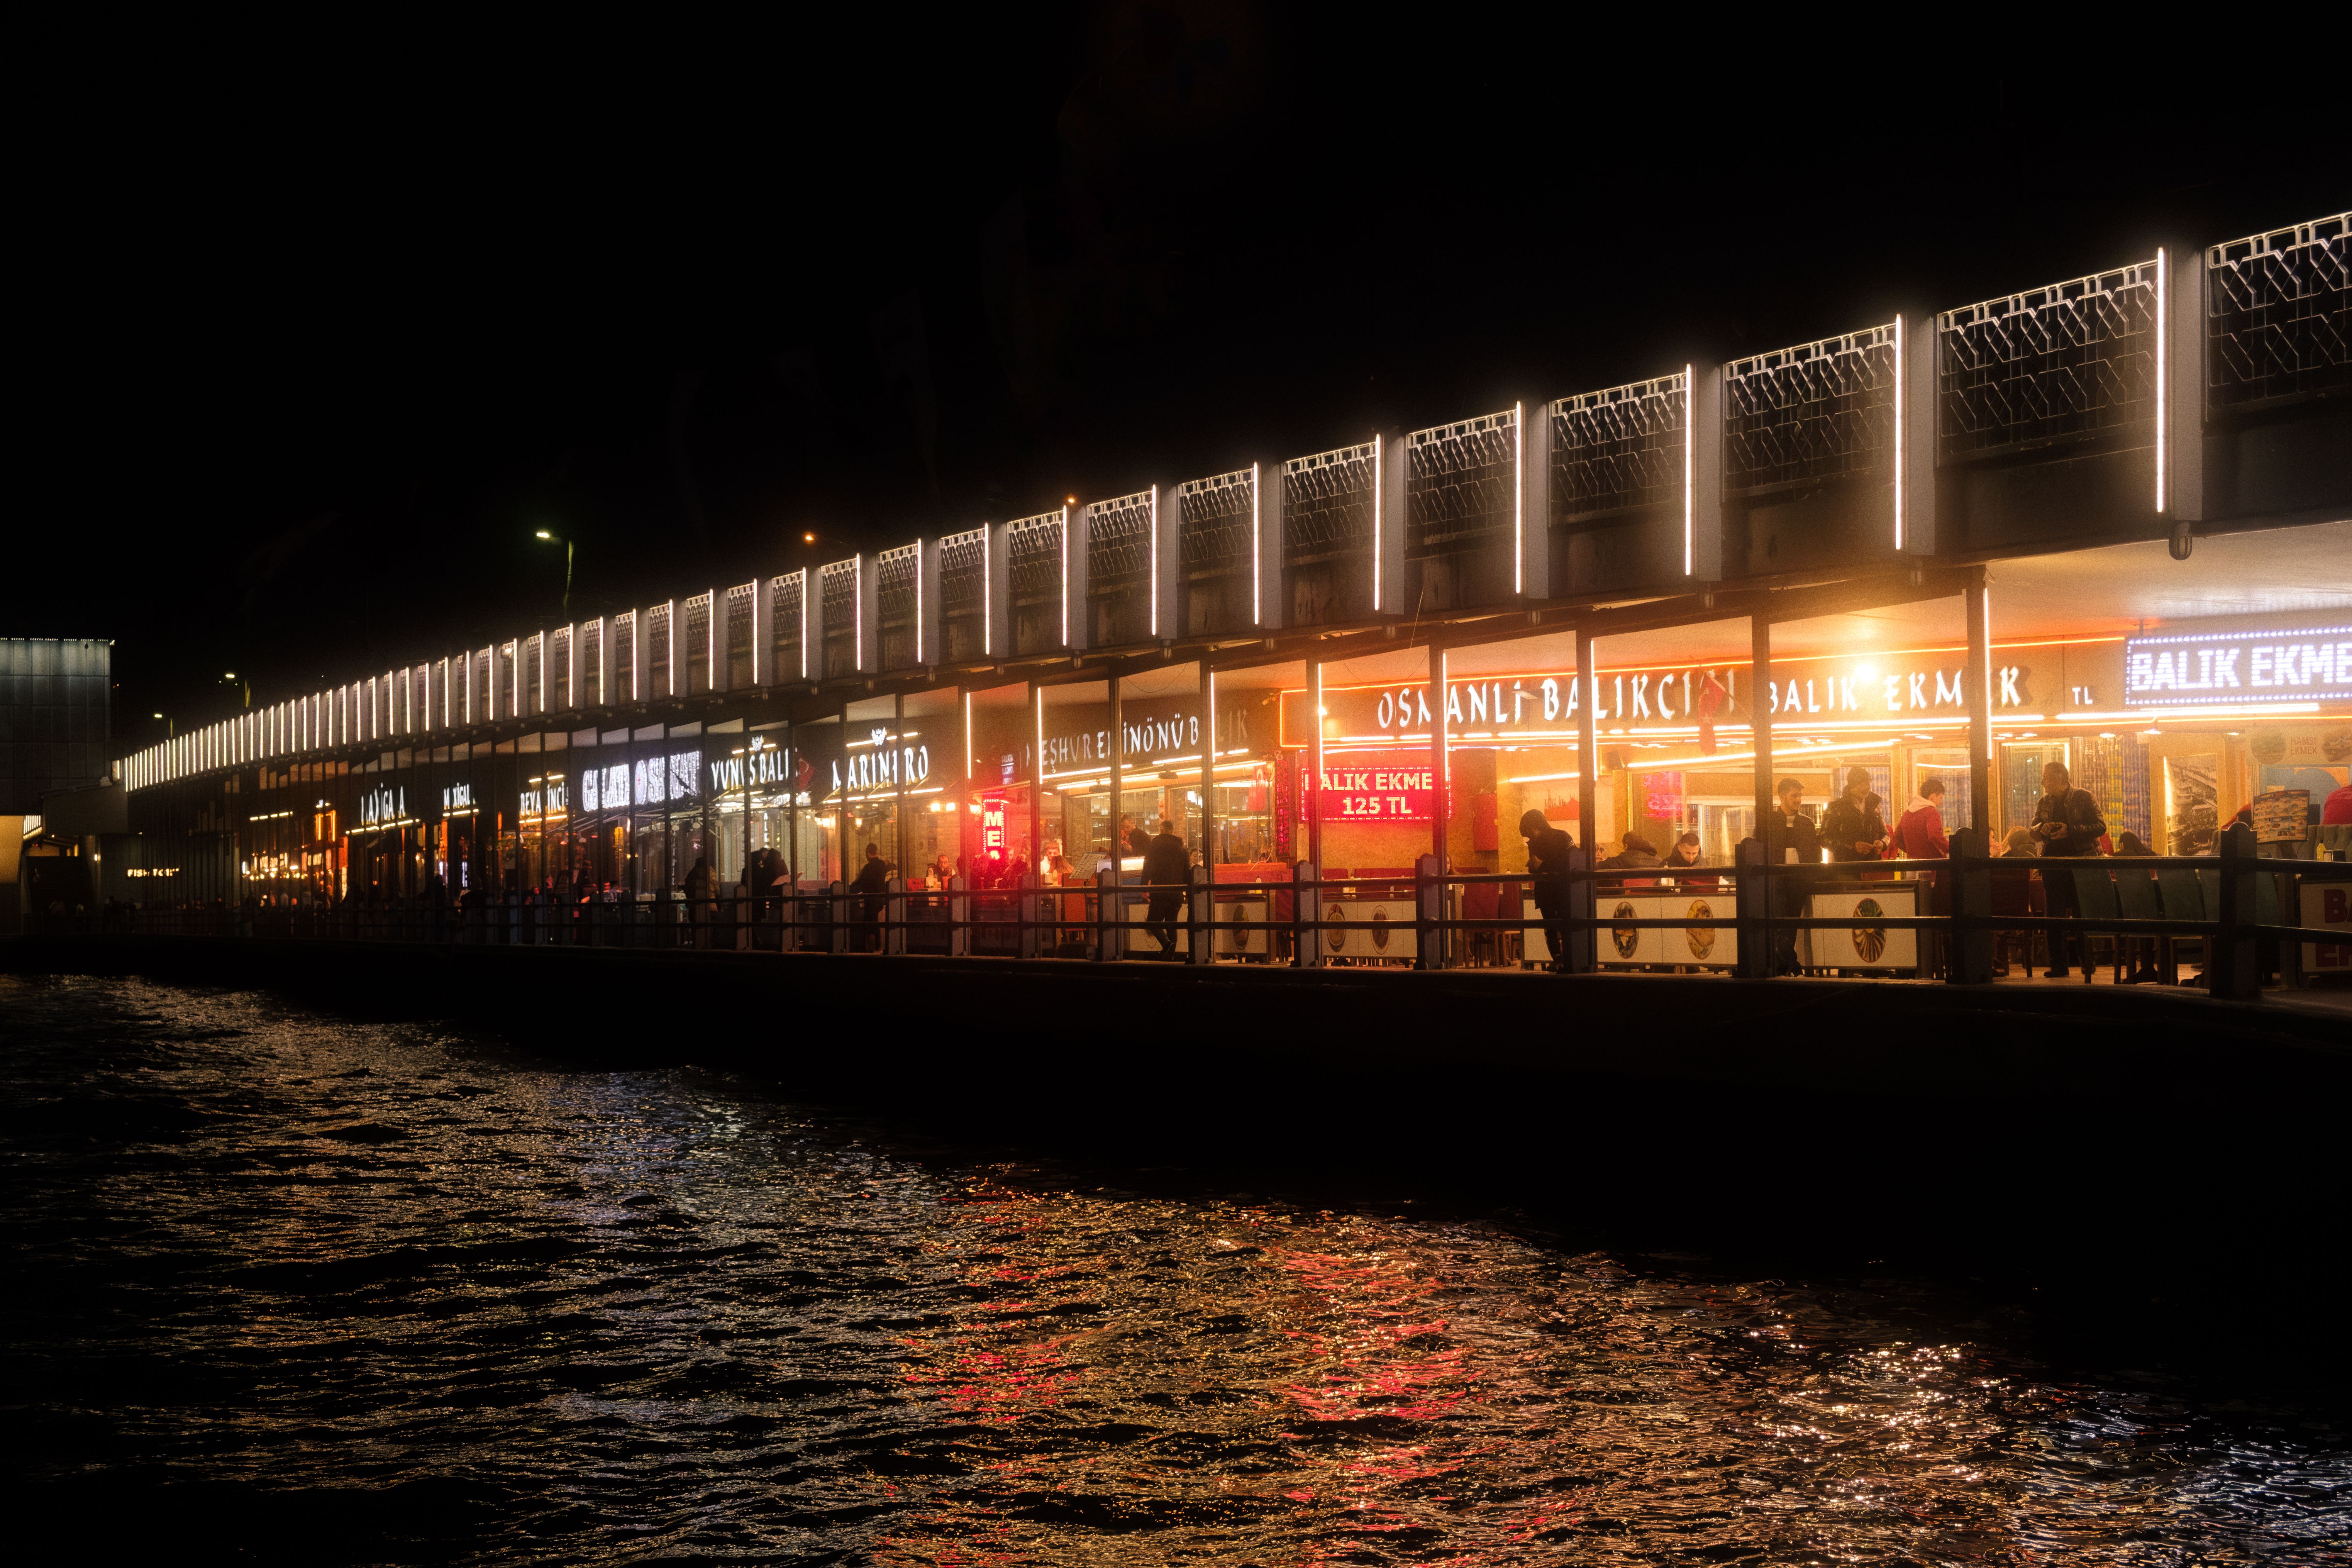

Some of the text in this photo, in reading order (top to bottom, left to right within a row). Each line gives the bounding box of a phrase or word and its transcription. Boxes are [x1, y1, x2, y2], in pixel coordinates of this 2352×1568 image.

[2131, 642, 2352, 690] BALIK EKME
[1540, 668, 1734, 721] BALIKCII
[1883, 666, 2022, 711] EKMK
[2072, 686, 2093, 705] TL
[1097, 713, 1183, 759] EİNÖNÜ
[2290, 746, 2318, 754] EKMEK
[759, 748, 798, 784] BALI
[1376, 773, 1449, 790] EKME
[444, 782, 476, 810] MXİGAL
[520, 790, 542, 816] BEYA
[1343, 797, 1412, 814] 125 TL
